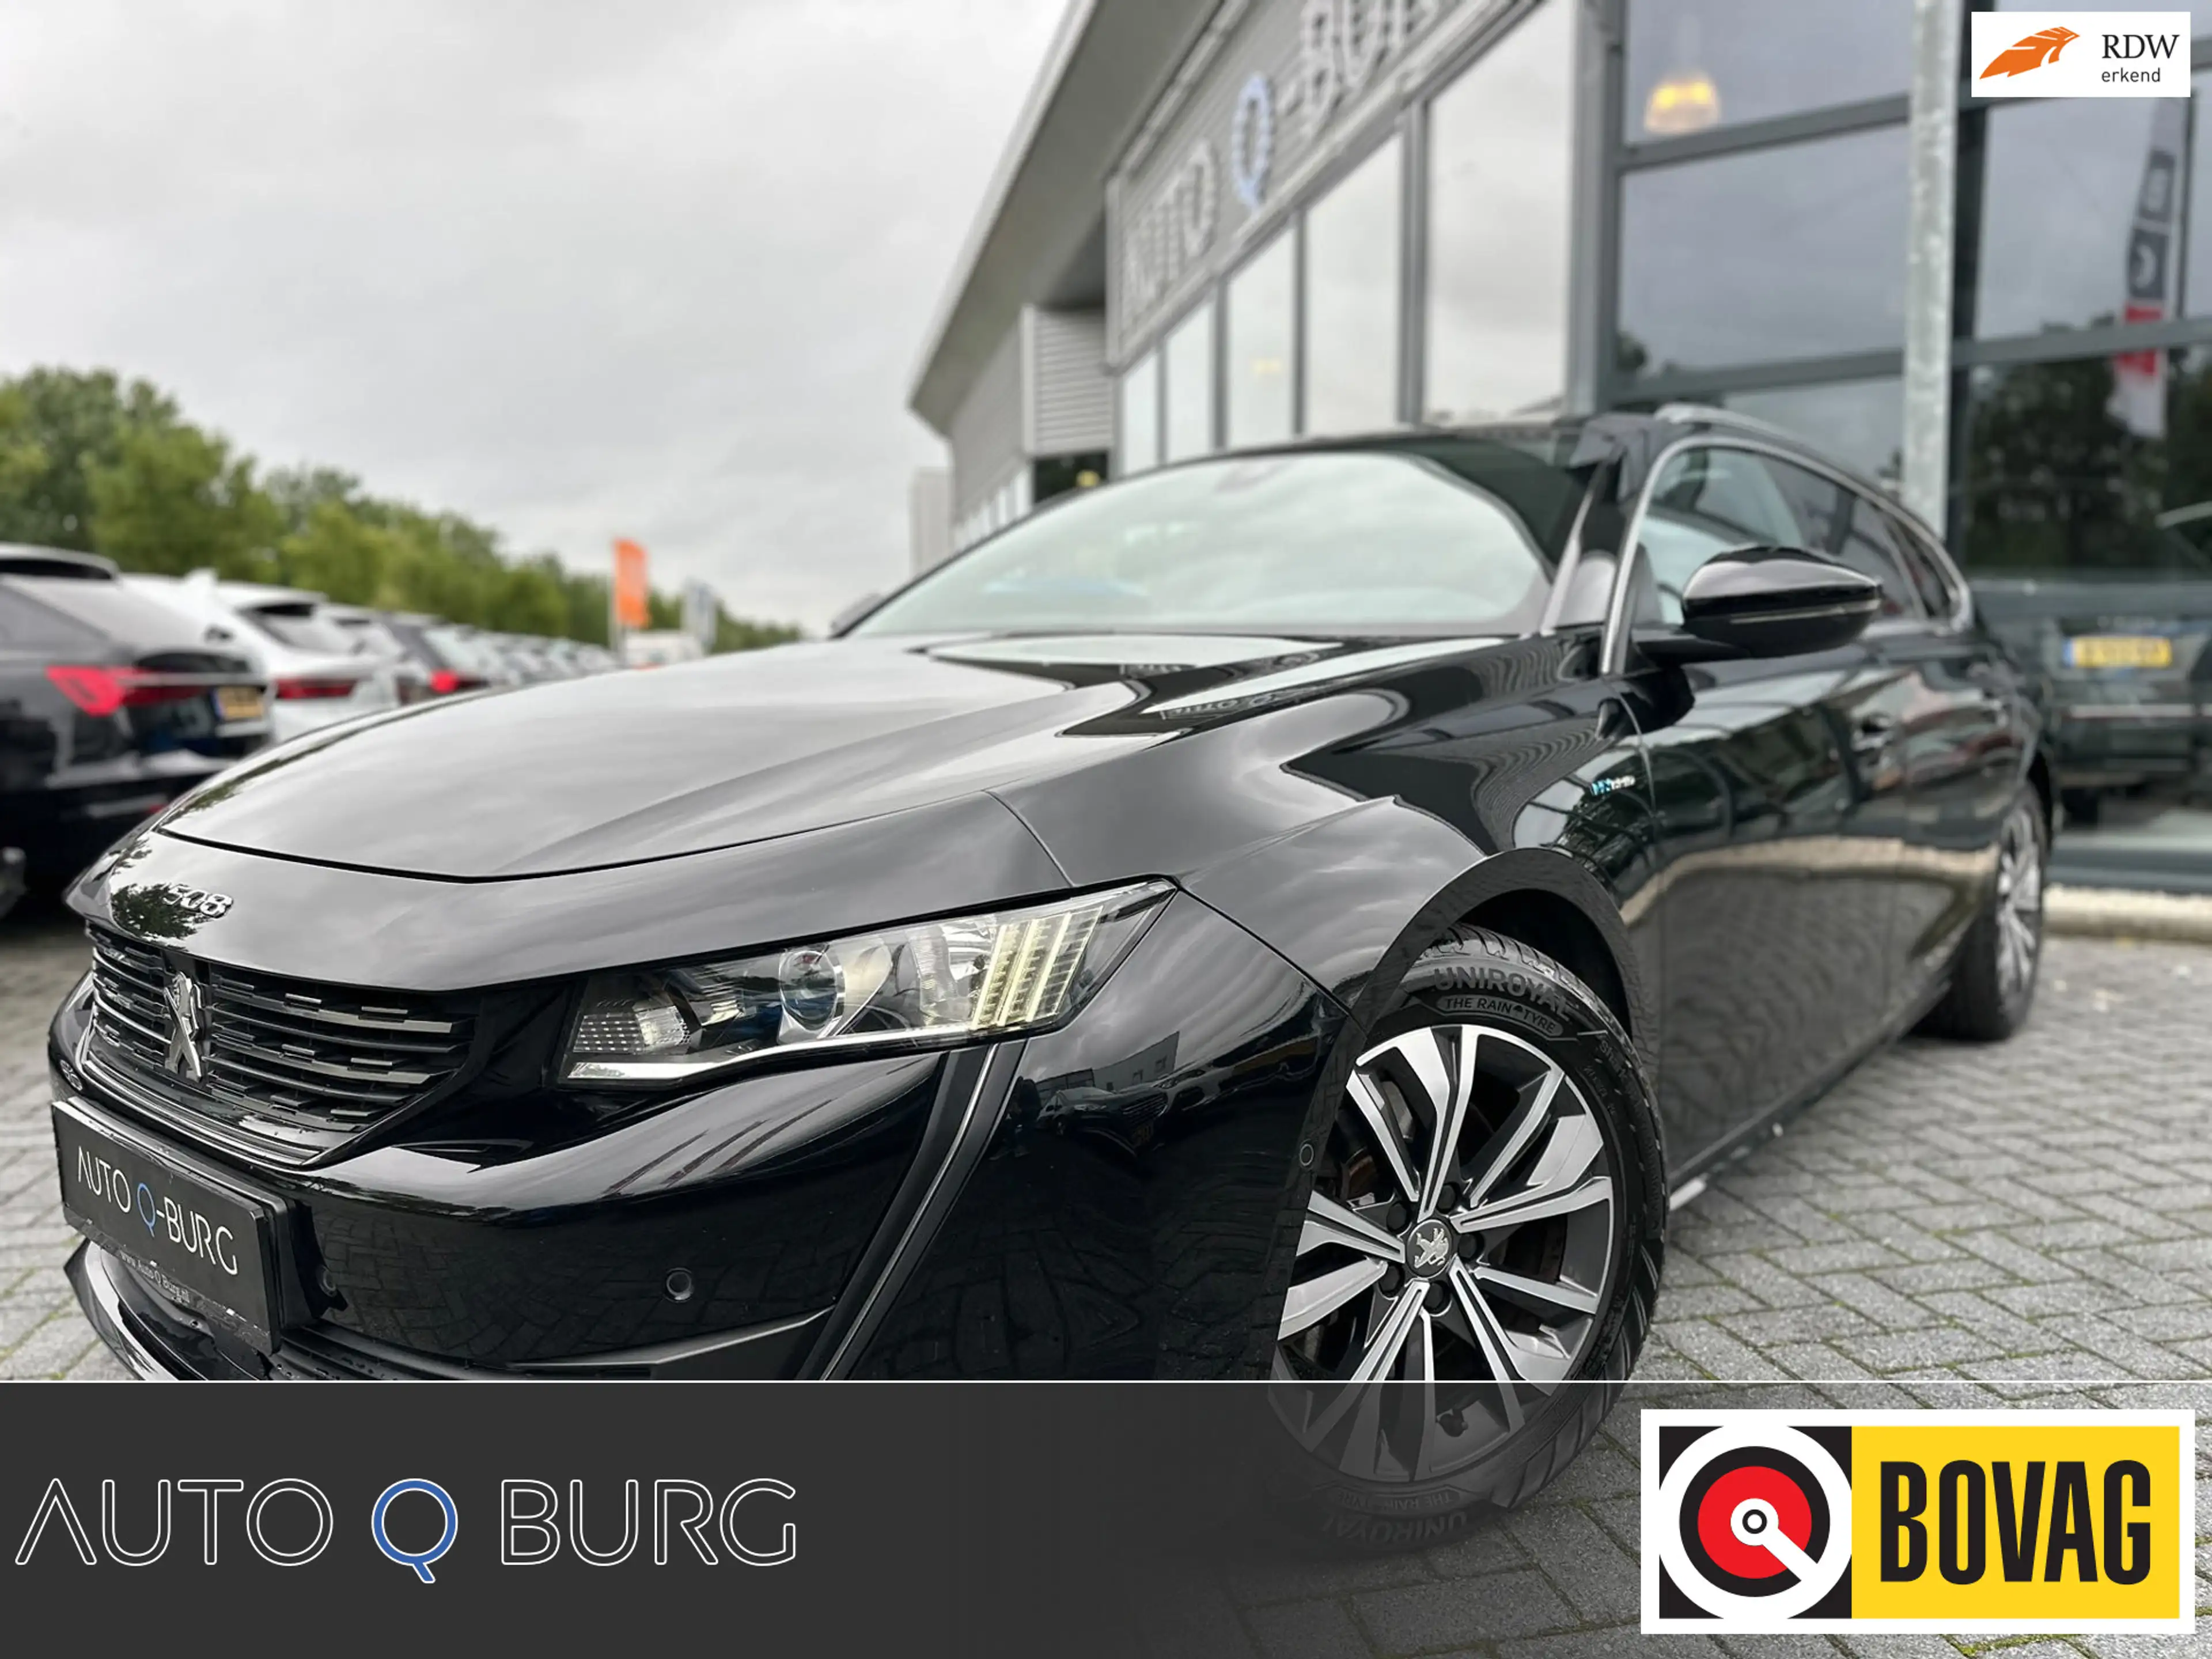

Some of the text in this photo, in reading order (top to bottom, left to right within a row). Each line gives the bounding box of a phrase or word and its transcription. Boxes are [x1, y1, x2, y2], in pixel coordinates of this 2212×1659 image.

[163, 885, 234, 917] 508
[1434, 967, 1570, 1022] UNIROYAL
[1445, 997, 1556, 1035] THE RAIN TYRE
[77, 1146, 238, 1275] AUTO Q-BURG
